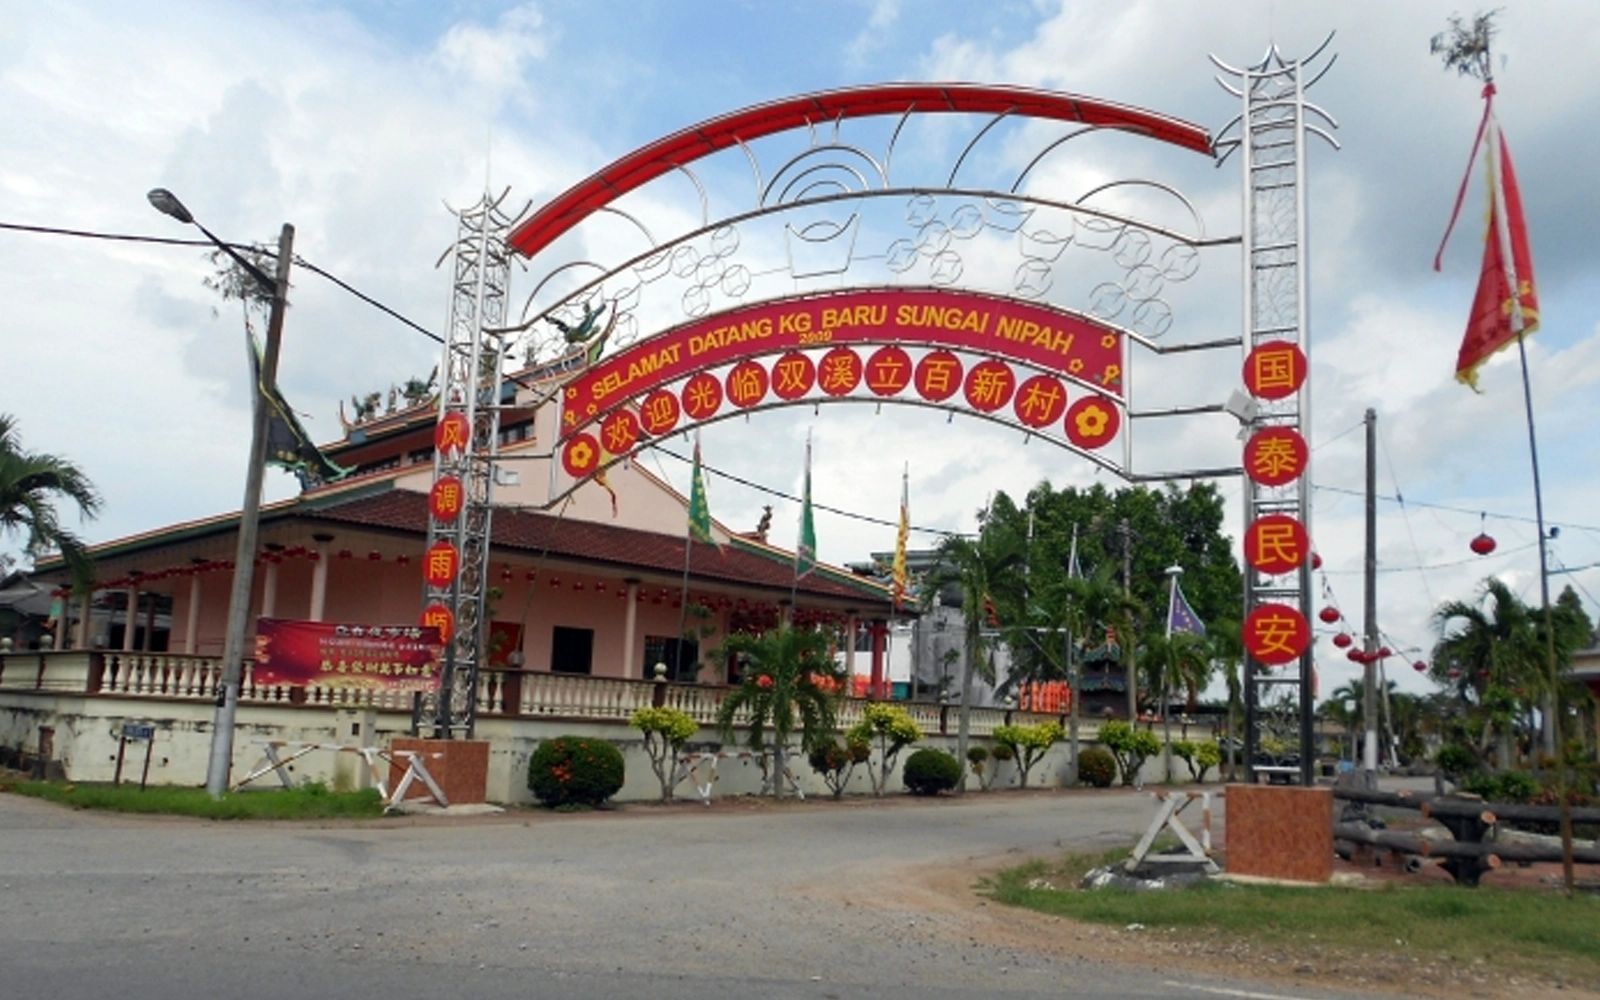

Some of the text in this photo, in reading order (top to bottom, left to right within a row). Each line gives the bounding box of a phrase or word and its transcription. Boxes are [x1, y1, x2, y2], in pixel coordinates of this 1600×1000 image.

[591, 305, 1074, 400] SELAMAT DATANG KG BARU SUNGAI NIPAH
[604, 355, 1060, 448] 欢迎光临双溪立百新村
[1254, 350, 1298, 655] 国泰民安
